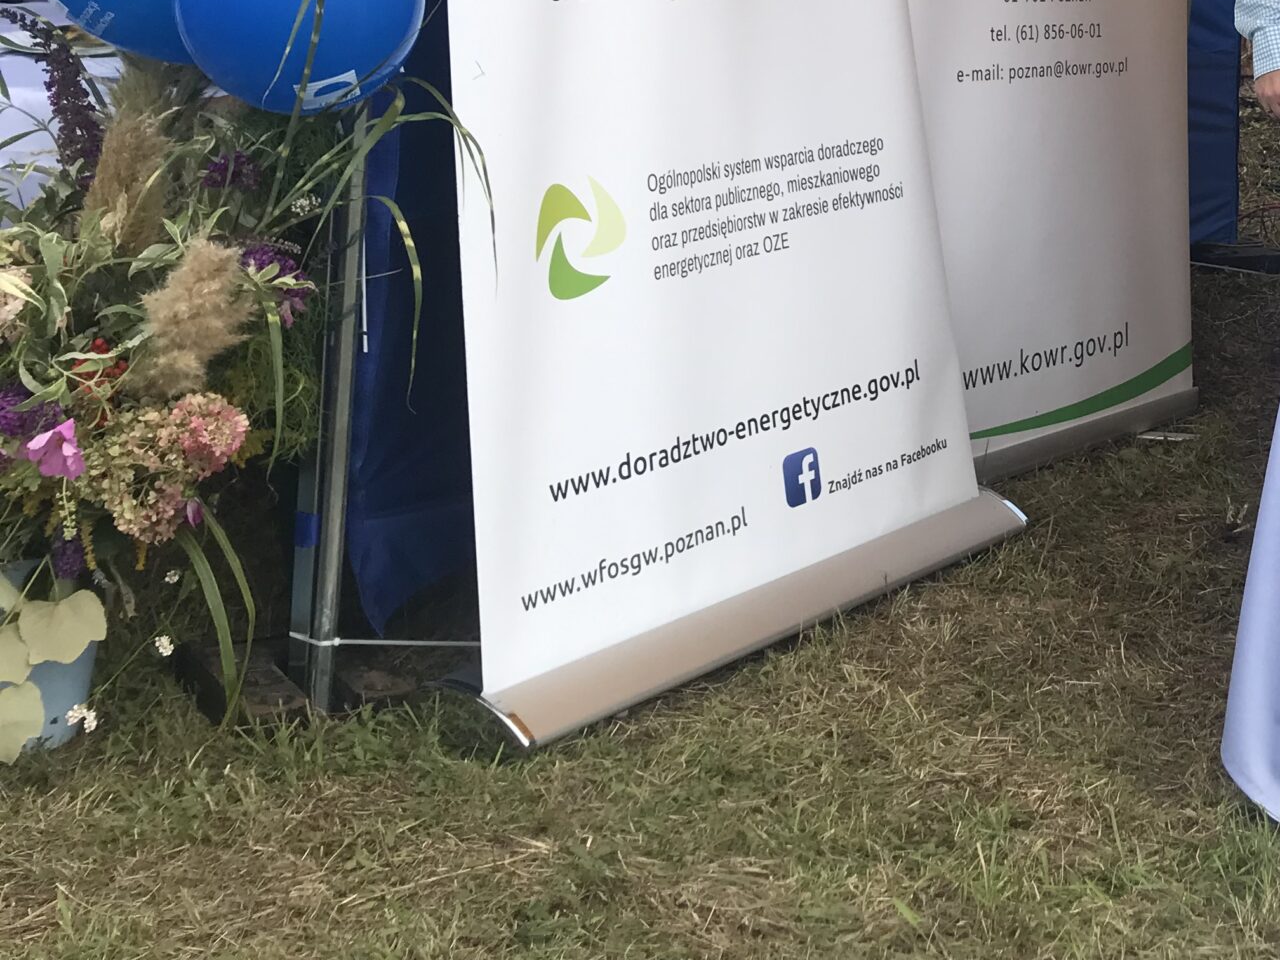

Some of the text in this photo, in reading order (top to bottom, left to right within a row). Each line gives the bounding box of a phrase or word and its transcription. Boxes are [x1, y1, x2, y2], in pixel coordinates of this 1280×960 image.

[989, 23, 1102, 44] tel. (61) 856-06-01
[956, 57, 1129, 84] e-mail: poznan@kowr.gov.pl
[647, 136, 884, 195] Ogólnopolski system wsparcia doradczego
[649, 162, 881, 222] dla sektora publicznego, mieszkaniowego
[651, 181, 904, 251] oraz przedsiębiorstw w zakresie efektywności
[653, 231, 790, 281] energetycznej oraz OZE
[962, 321, 1129, 390] www.kowr.gov.pl
[549, 359, 921, 503] www.doradztwo-energetyczne.gov.pl
[827, 437, 948, 495] Znajdź nas na Facebooku
[520, 506, 748, 611] www.wfosgw.poznan.pl
